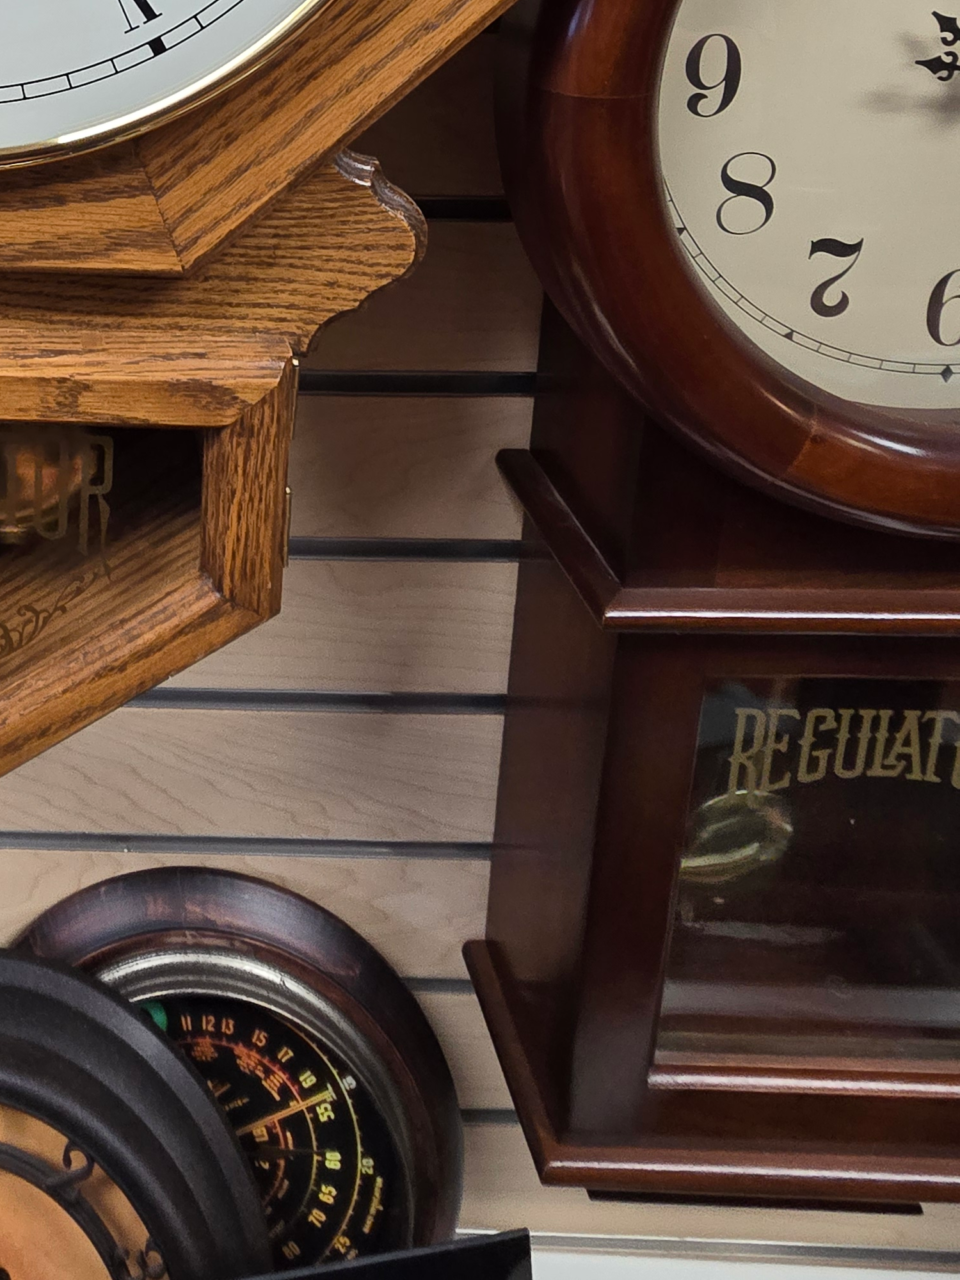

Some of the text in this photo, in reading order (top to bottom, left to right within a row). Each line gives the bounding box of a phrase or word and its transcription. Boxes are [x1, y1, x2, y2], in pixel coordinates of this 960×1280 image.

[685, 33, 742, 118] 9
[715, 152, 778, 236] 8
[807, 237, 865, 318] 7
[181, 1014, 192, 1031] 11
[202, 1015, 215, 1032] 12
[221, 1017, 235, 1035] 13
[252, 1029, 268, 1047] 15
[277, 1046, 294, 1063] 17
[299, 1070, 317, 1089] 19
[316, 1103, 335, 1122] 55
[325, 1151, 341, 1170] 60
[361, 1157, 374, 1175] 20
[318, 1183, 337, 1205] 65
[308, 1208, 327, 1228] 70
